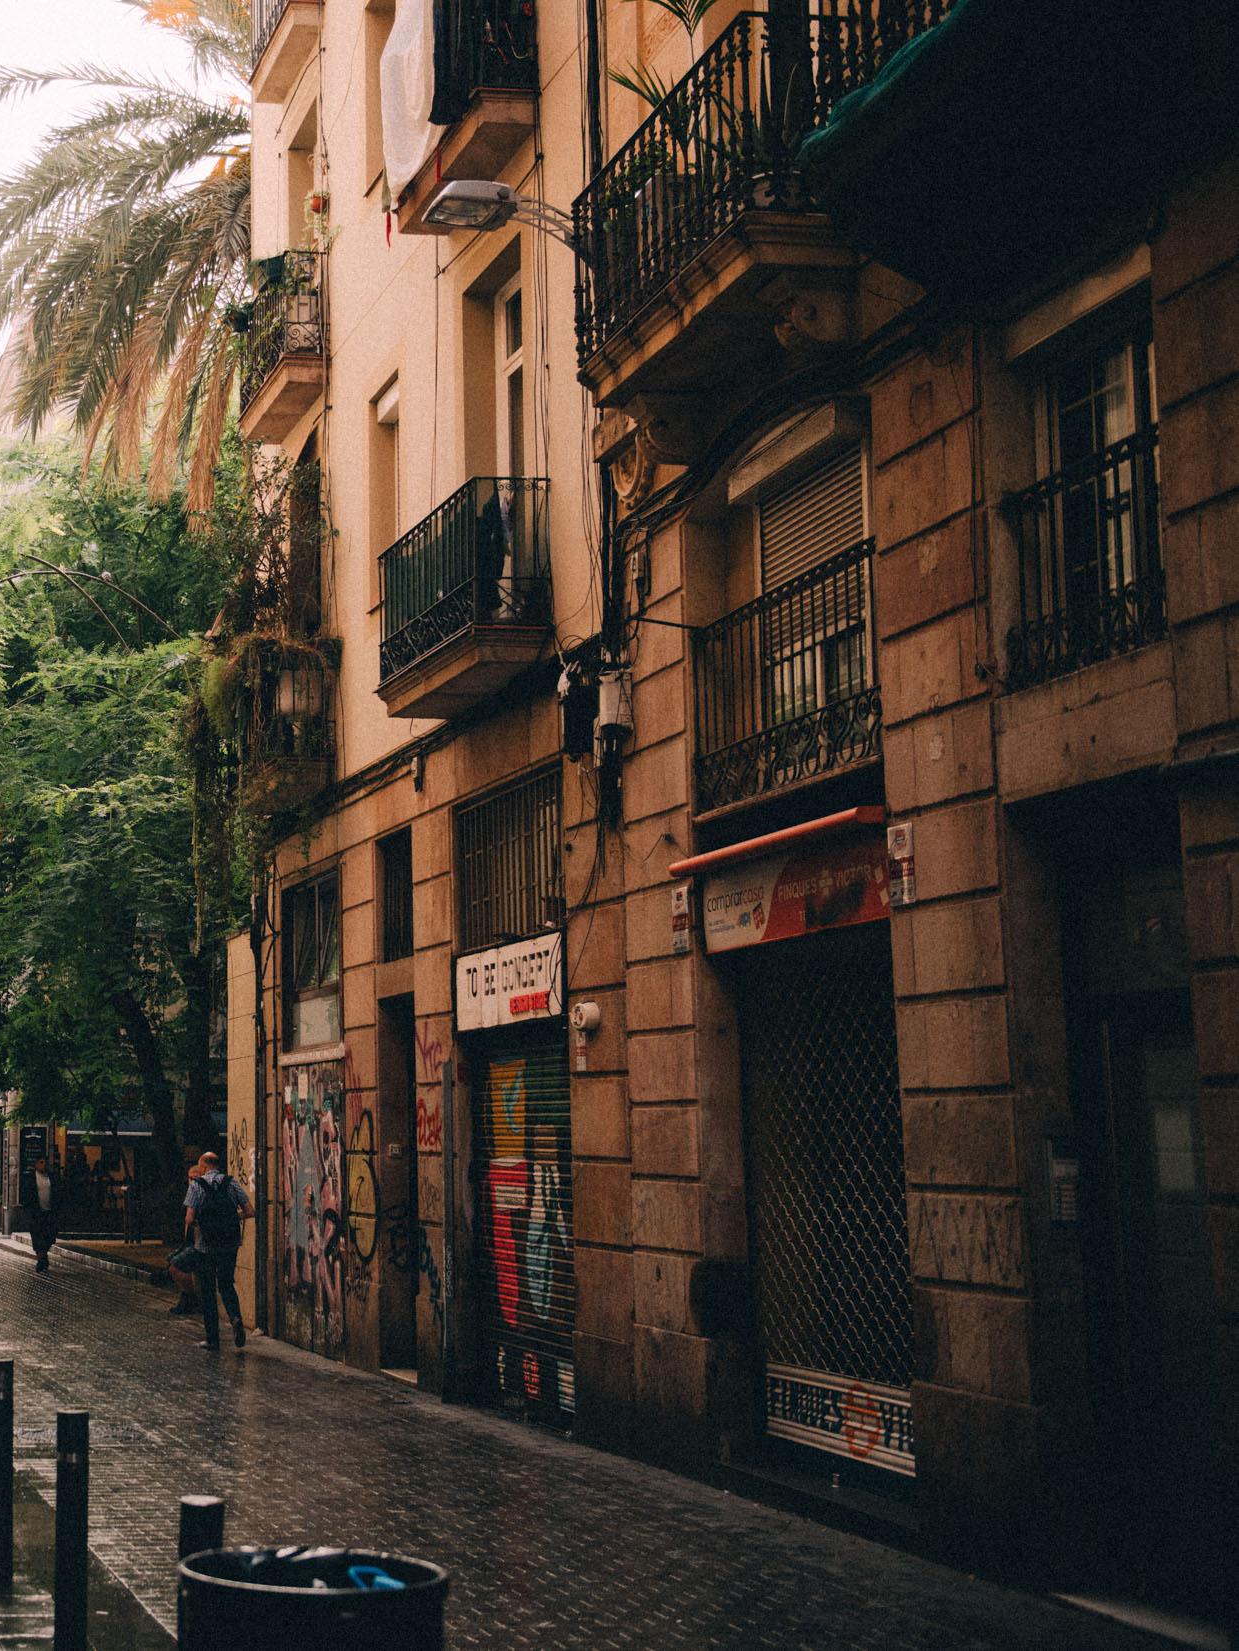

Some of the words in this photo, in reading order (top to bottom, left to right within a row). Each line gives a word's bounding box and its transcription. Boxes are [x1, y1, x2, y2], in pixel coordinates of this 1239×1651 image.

[778, 879, 817, 900] FINQUES
[834, 864, 872, 888] VICTOR
[466, 966, 478, 998] TO
[484, 963, 496, 996] BE
[502, 949, 550, 993] CONCEPT
